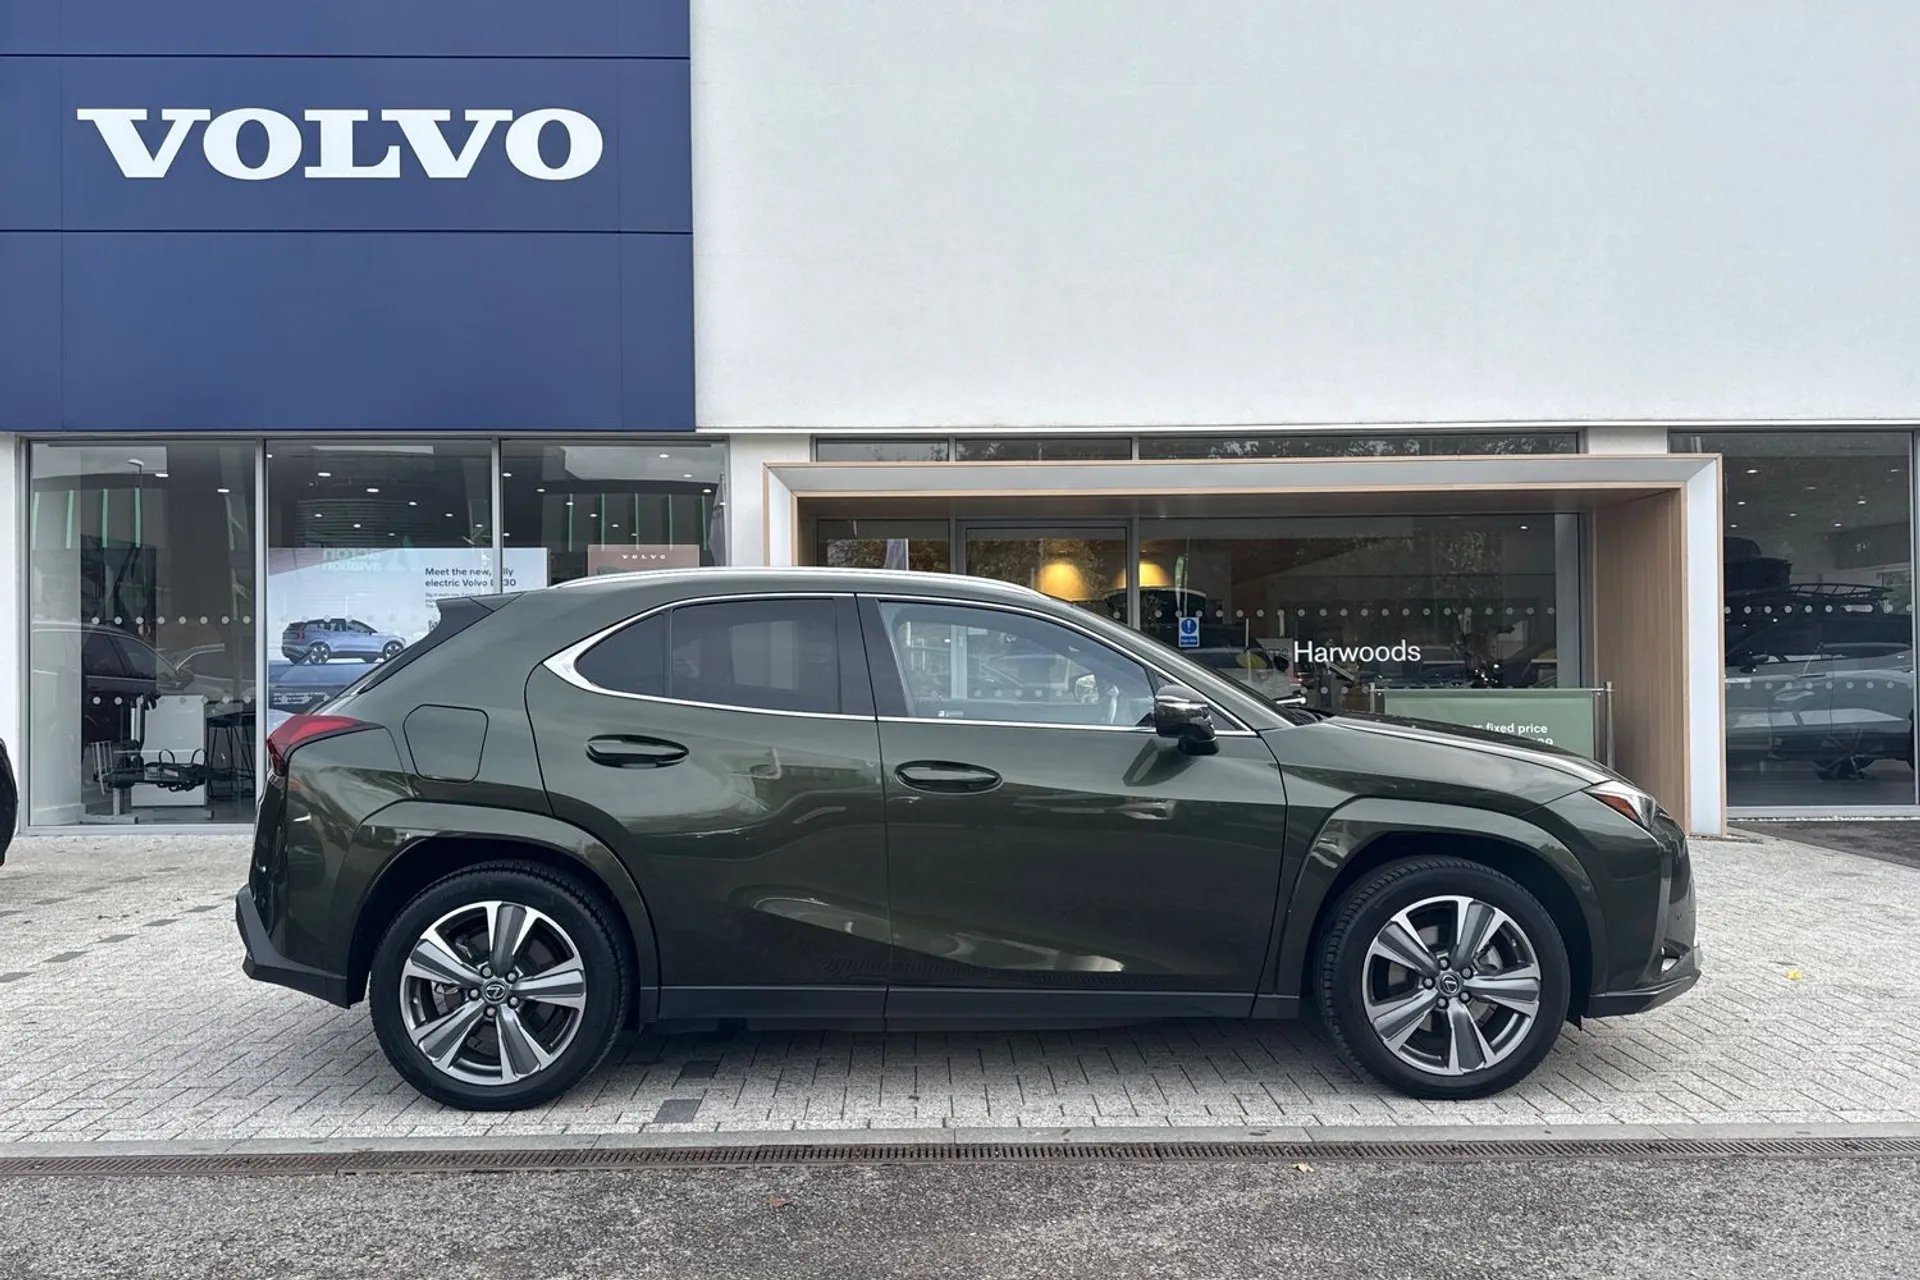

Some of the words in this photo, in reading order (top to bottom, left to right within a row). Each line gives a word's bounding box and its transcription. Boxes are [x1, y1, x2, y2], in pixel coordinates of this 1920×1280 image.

[77, 108, 603, 181] VOLVO
[425, 567, 449, 576] Meet
[452, 567, 467, 576] the
[469, 568, 492, 577] new,
[425, 578, 460, 588] electric
[462, 578, 488, 588] Volvo
[1294, 639, 1421, 662] Harwoods
[1486, 722, 1515, 733] fixed
[1518, 723, 1548, 736] price
